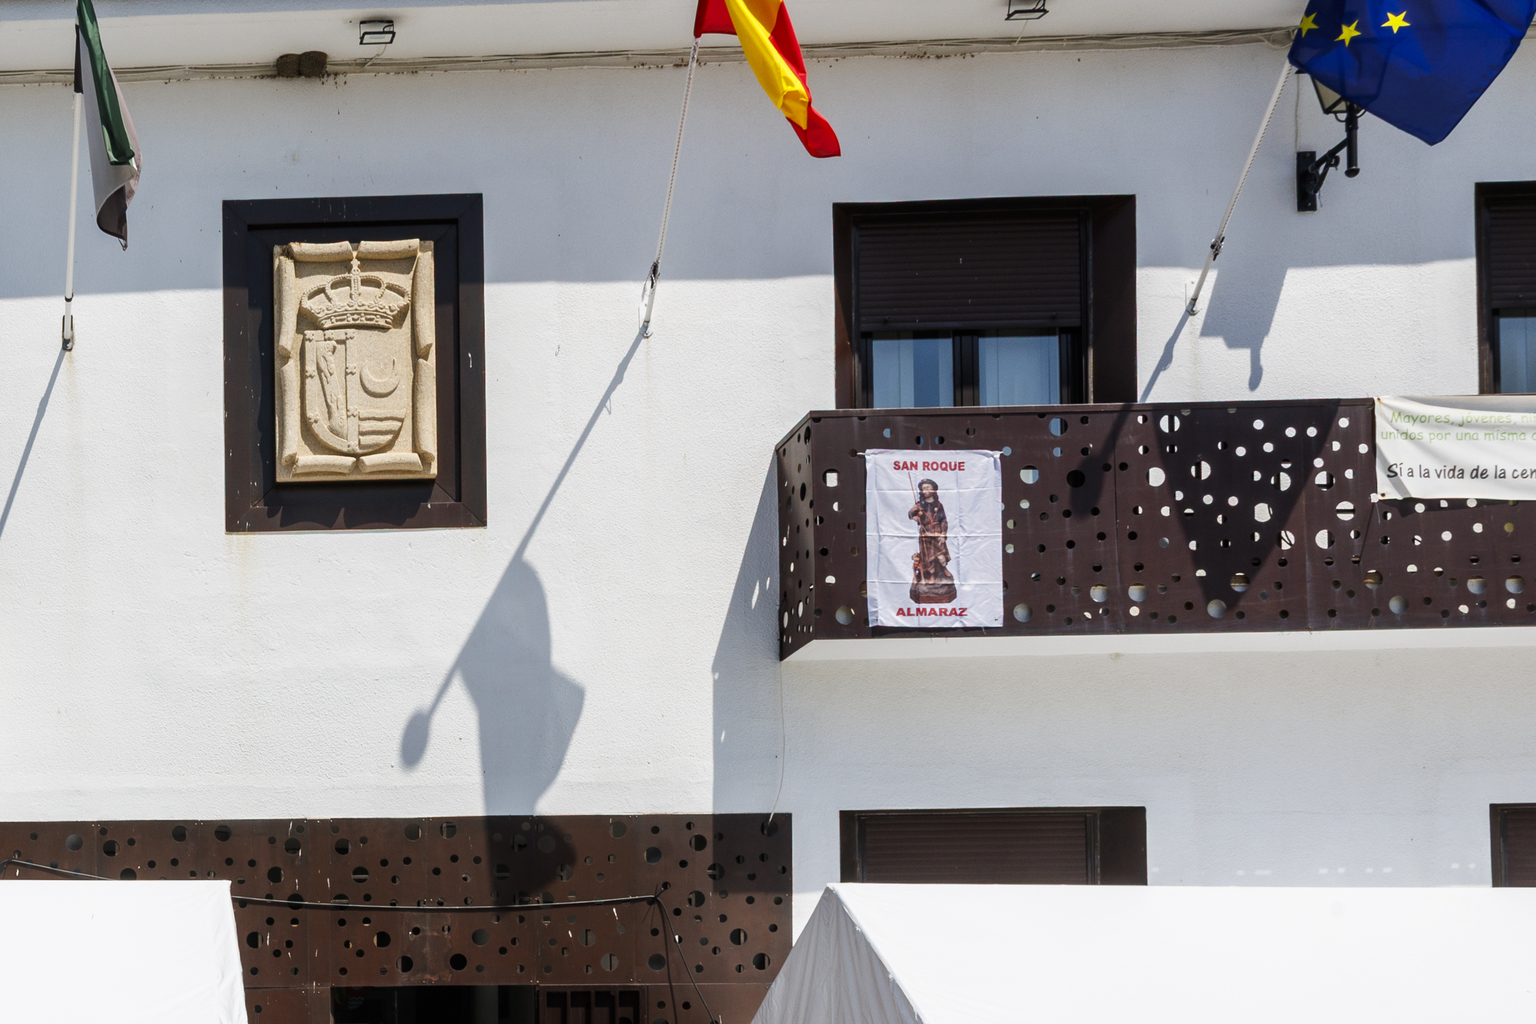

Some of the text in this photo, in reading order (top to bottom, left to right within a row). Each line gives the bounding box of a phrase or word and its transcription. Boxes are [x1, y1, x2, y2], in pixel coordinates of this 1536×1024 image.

[1390, 411, 1455, 426] Mayores,
[1458, 412, 1517, 427] jóvenes,
[1381, 429, 1424, 441] unidos
[1429, 431, 1451, 443] por
[1456, 431, 1479, 441] una
[893, 461, 966, 472] SAN ROQUE
[1386, 462, 1404, 478] Sí
[1407, 467, 1414, 478] a
[1419, 464, 1431, 479] la
[1435, 465, 1465, 479] vida
[1470, 465, 1489, 479] de
[1494, 464, 1506, 479] la
[896, 607, 968, 617] ALMARAZ
